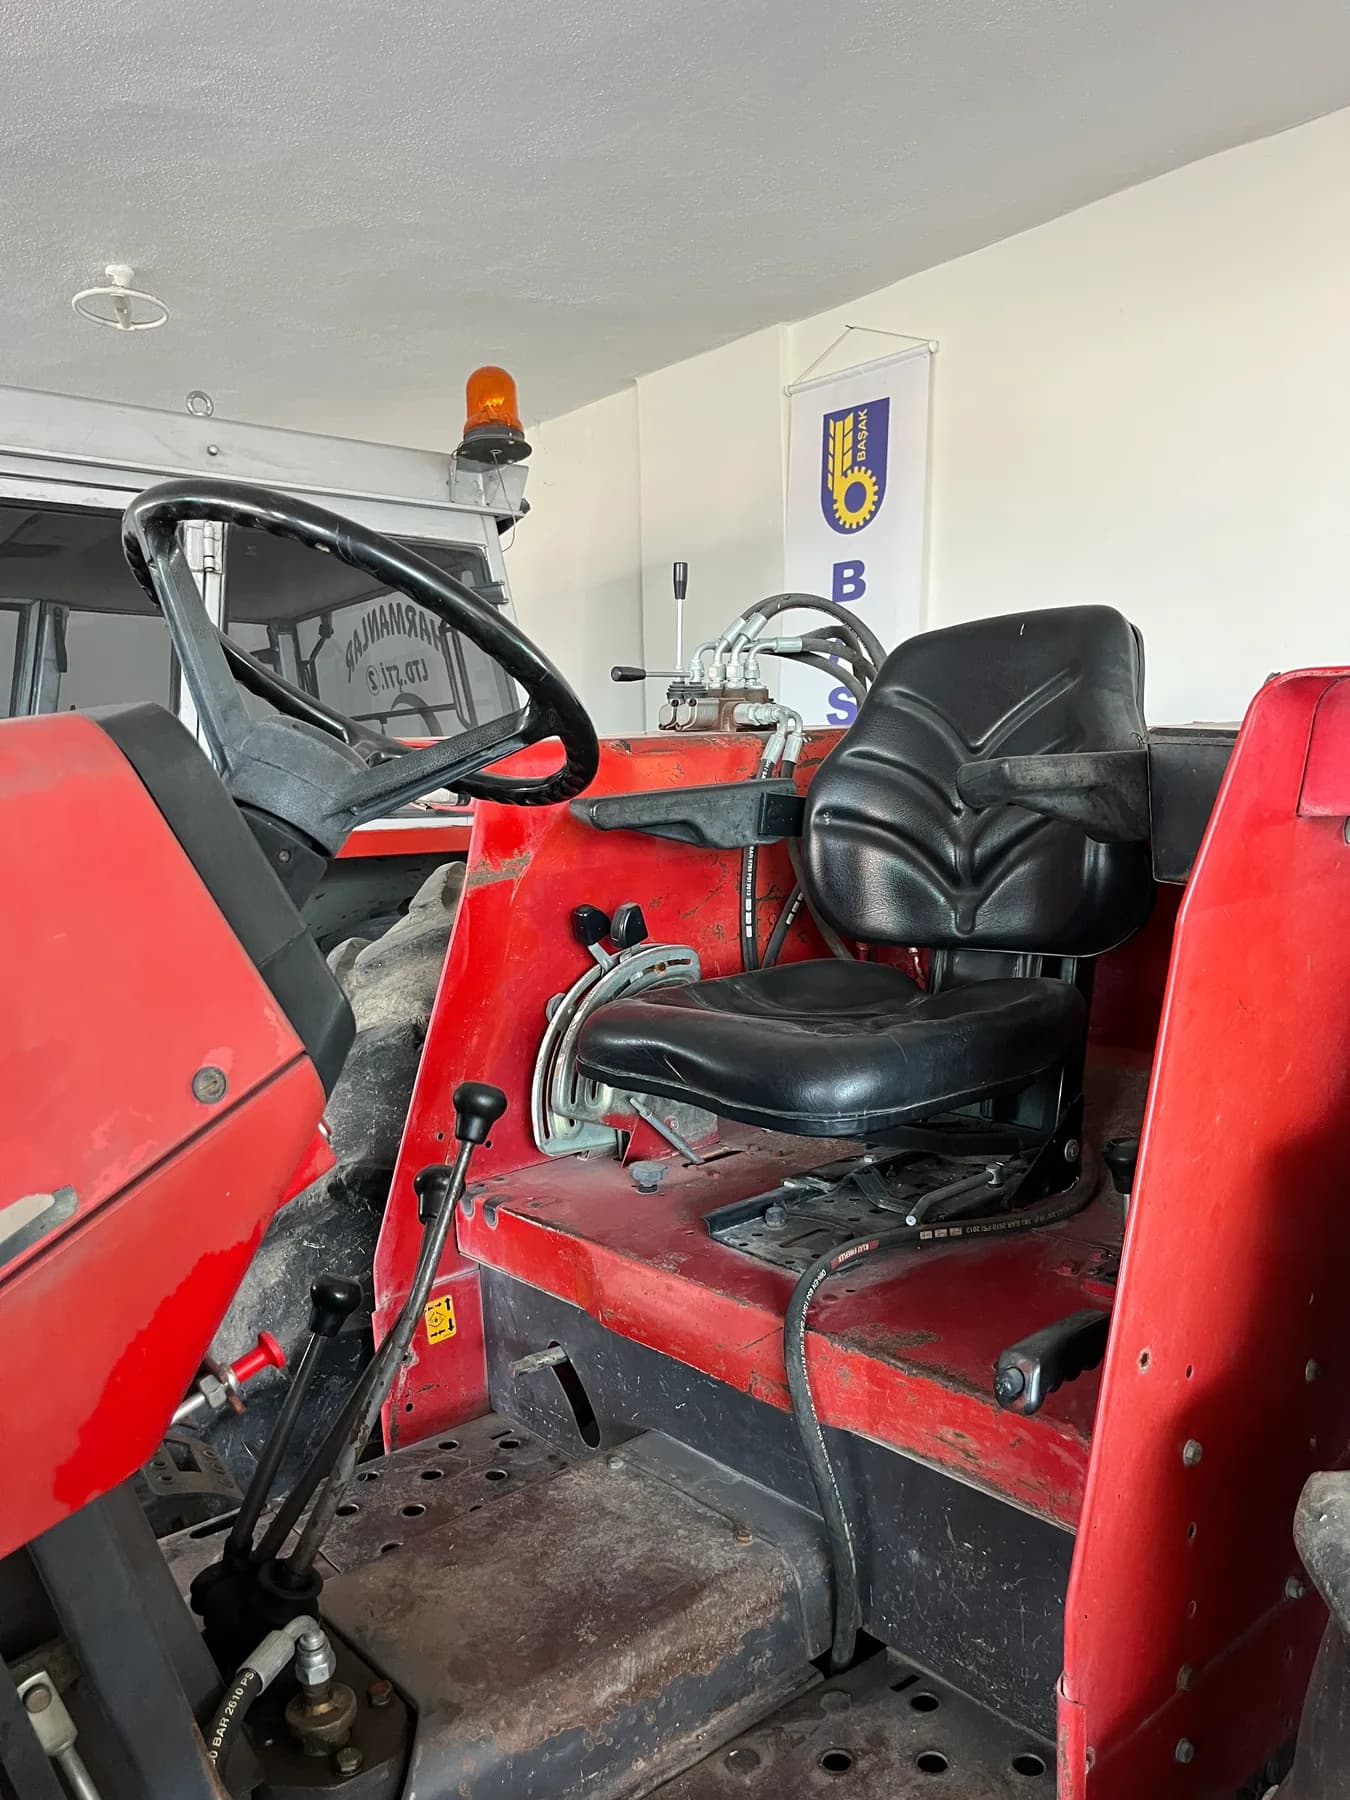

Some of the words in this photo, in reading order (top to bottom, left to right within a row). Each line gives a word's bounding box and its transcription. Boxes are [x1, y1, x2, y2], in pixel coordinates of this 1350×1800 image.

[856, 408, 869, 461] BAŞAK
[212, 1716, 230, 1746] BAR
[224, 1687, 244, 1716] 2610
